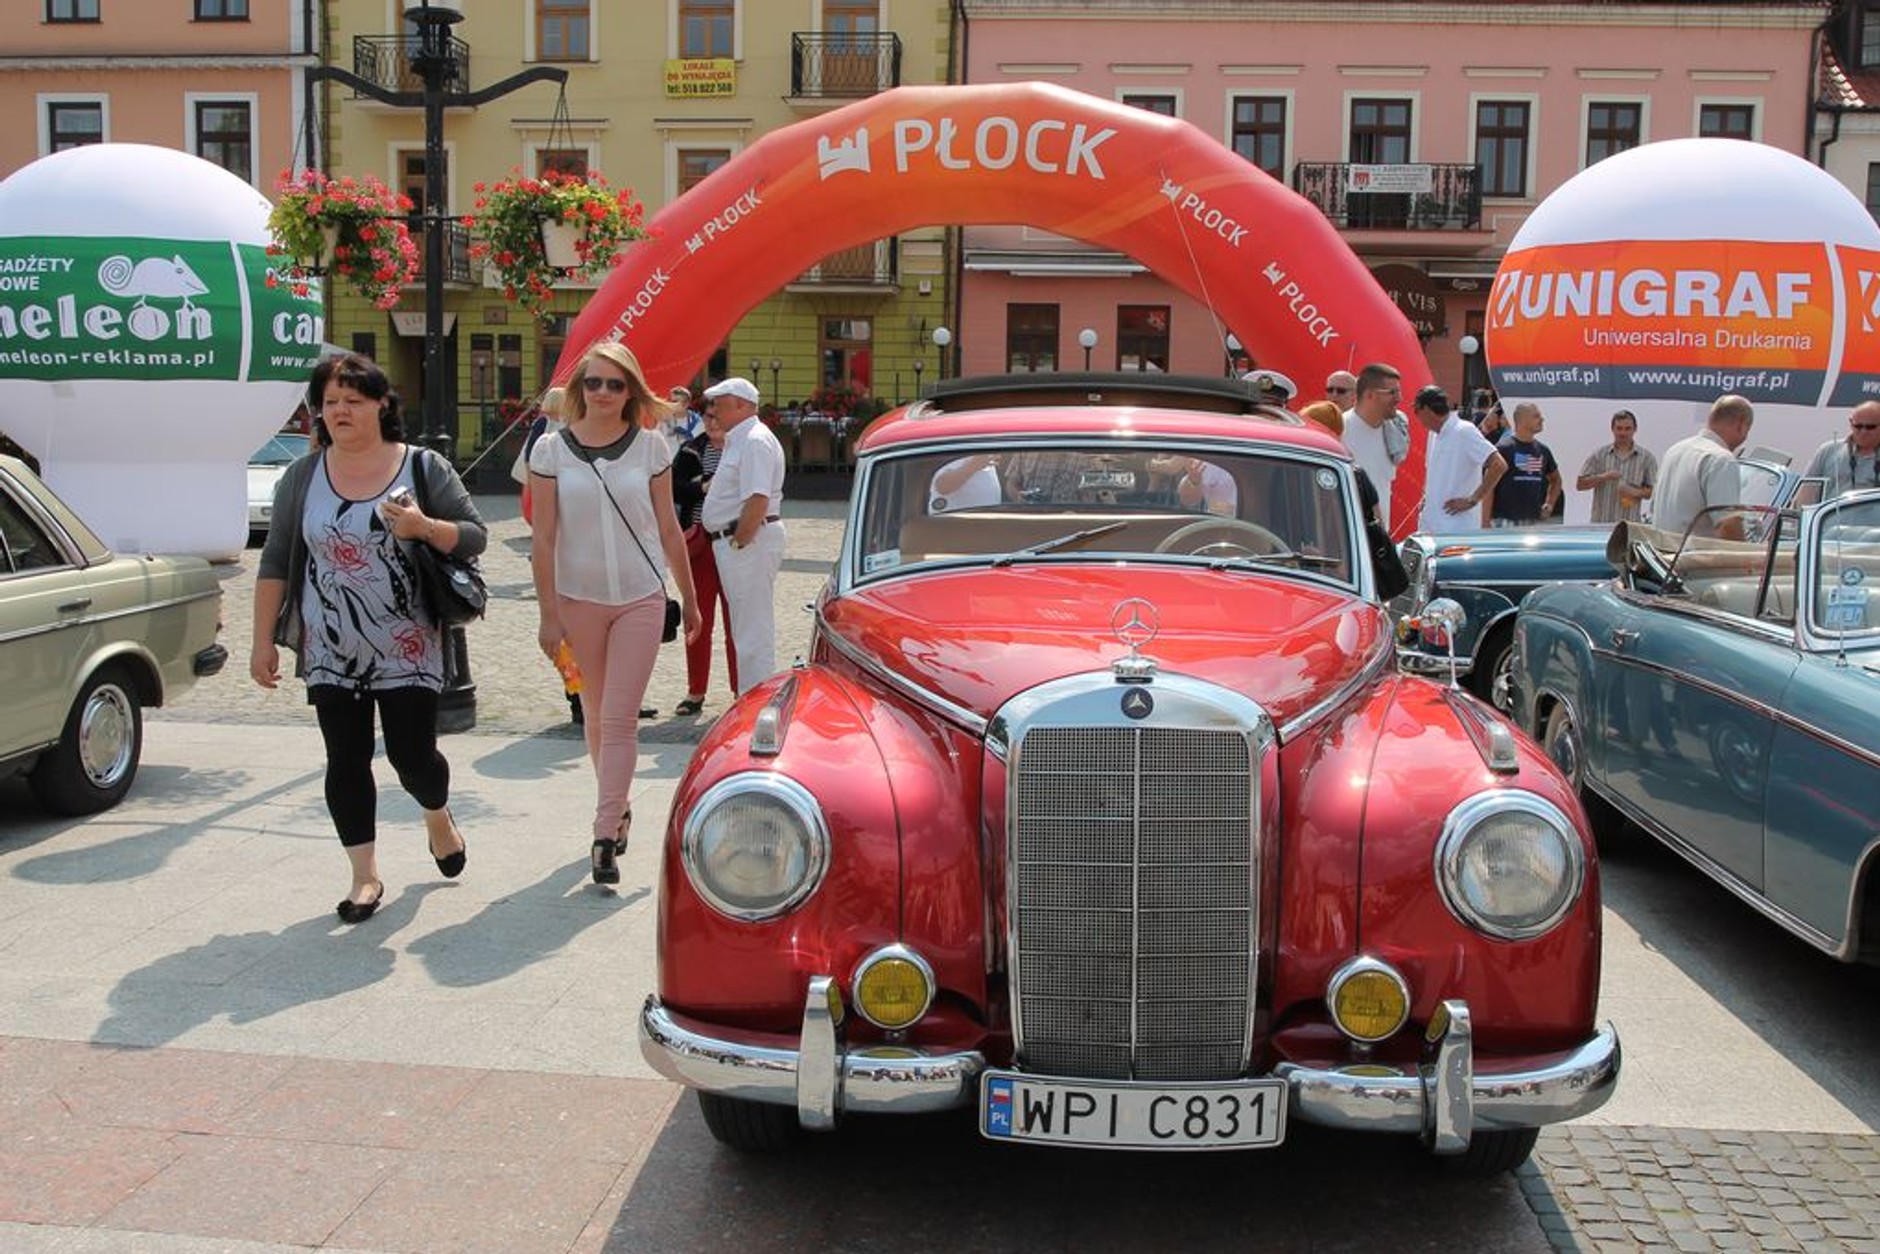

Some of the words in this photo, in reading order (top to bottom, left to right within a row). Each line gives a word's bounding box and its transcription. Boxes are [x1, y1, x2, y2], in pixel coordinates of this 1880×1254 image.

[893, 116, 1118, 180] PŁOCK
[702, 187, 763, 240] PŁOCK
[1180, 193, 1249, 247] PŁOCK
[0, 275, 40, 290] OWE
[620, 267, 670, 329] PŁOCK
[1520, 269, 1811, 319] UNIGRAF
[1279, 282, 1340, 348] PŁOCK
[1584, 327, 1706, 347] Uniwersalna
[1715, 330, 1811, 350] Drukarnia
[1502, 367, 1600, 385] www.unigraf.pl
[1628, 369, 1789, 391] www.unigraf.pl
[991, 1112, 1009, 1126] PL
[1022, 1088, 1118, 1138] WPI
[1150, 1091, 1264, 1139] C831
